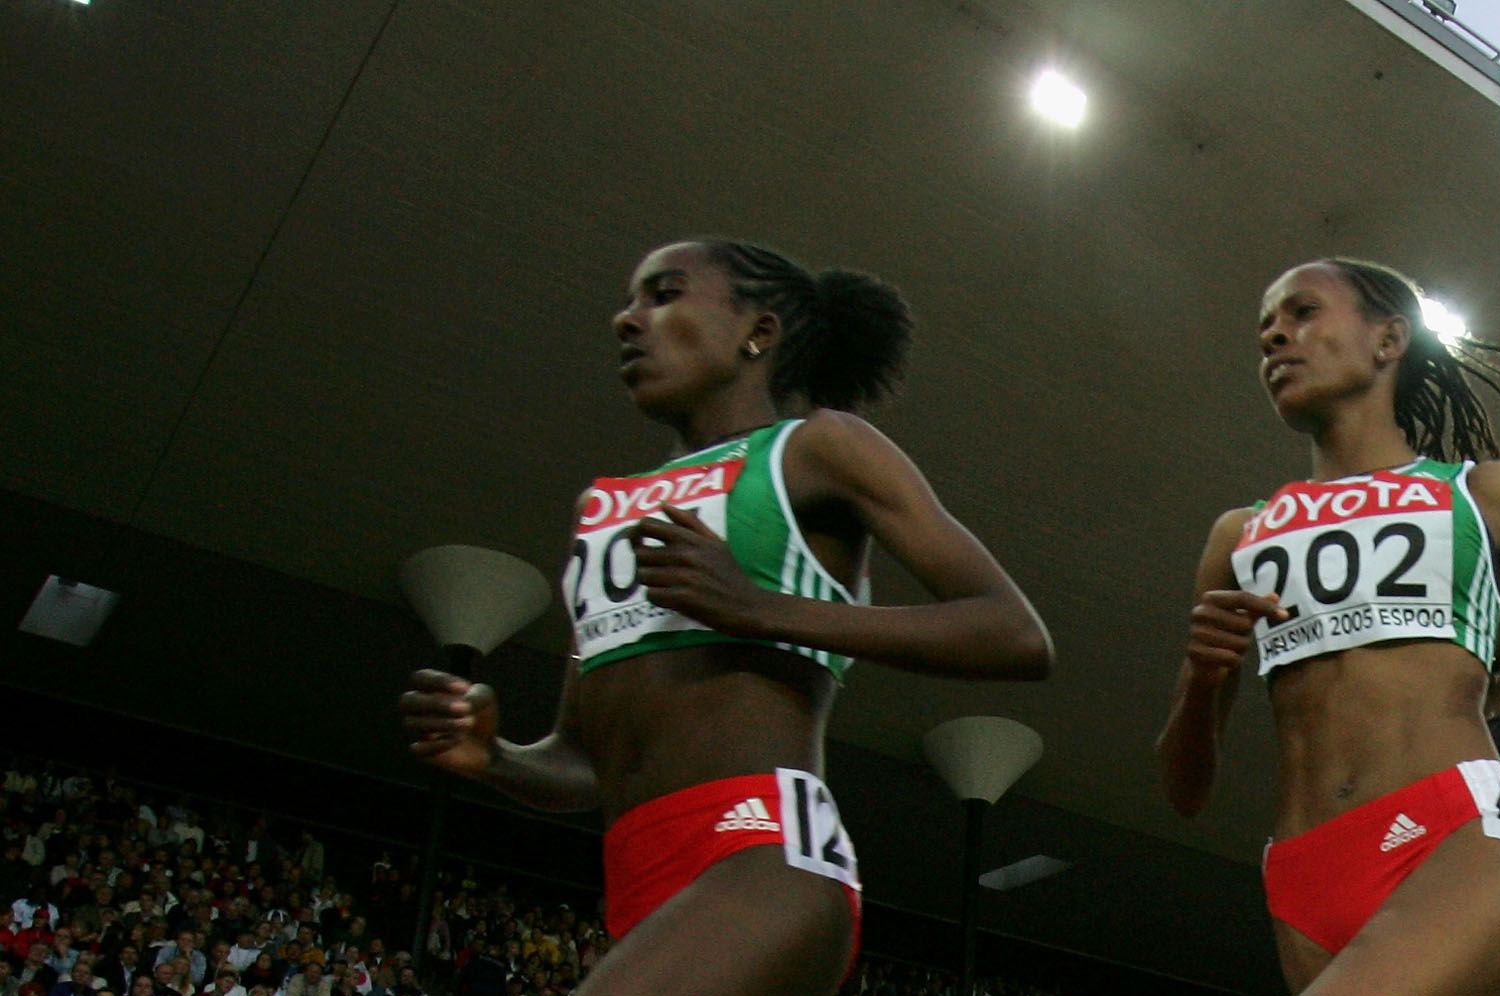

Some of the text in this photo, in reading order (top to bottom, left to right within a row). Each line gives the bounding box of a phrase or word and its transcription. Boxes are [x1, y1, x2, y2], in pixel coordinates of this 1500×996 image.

[577, 466, 725, 525] OYOTA
[1243, 481, 1439, 541] TOYOTA
[1252, 522, 1428, 630] 202
[1330, 608, 1374, 637] 2005
[1380, 608, 1446, 628] ESPOO
